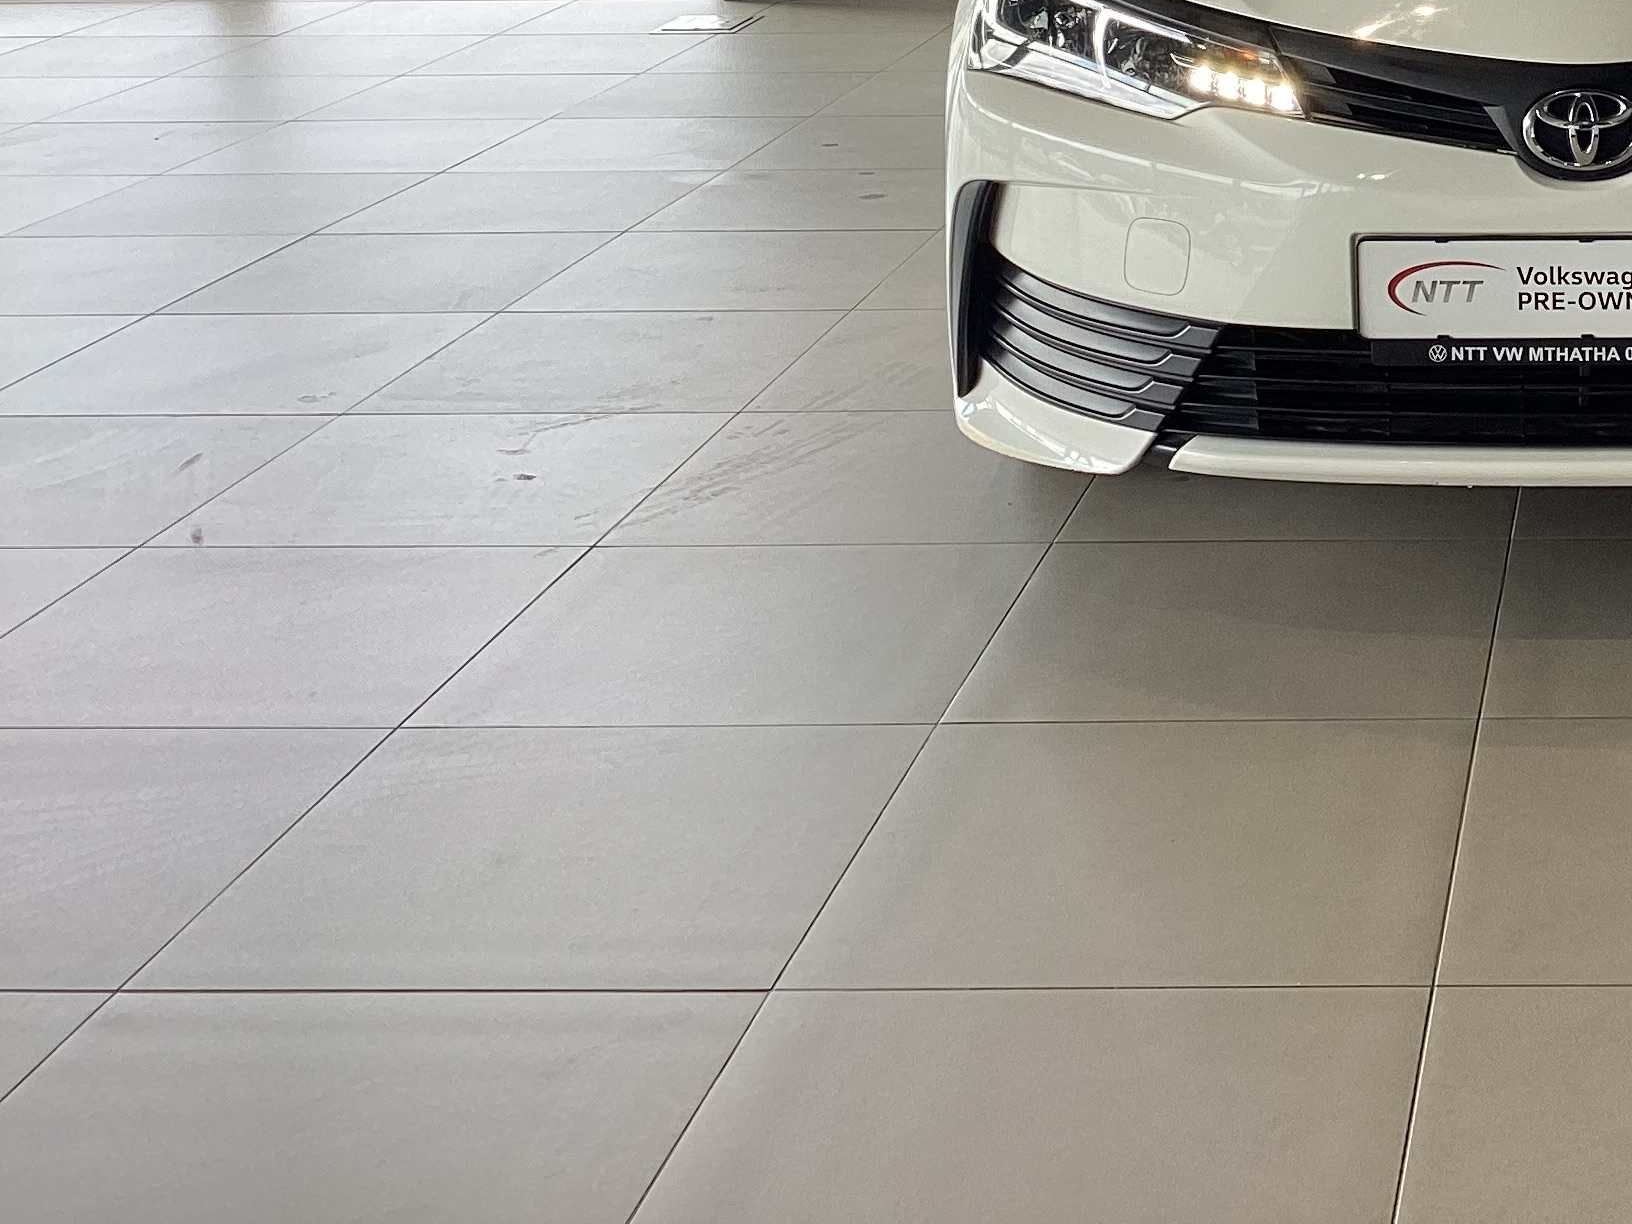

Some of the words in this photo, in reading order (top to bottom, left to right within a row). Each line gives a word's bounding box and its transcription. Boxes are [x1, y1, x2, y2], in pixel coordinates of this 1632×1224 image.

[1411, 279, 1485, 304] NTT
[1450, 346, 1488, 362] NTT
[1492, 346, 1523, 362] VW
[1528, 346, 1621, 362] MTHATHA
